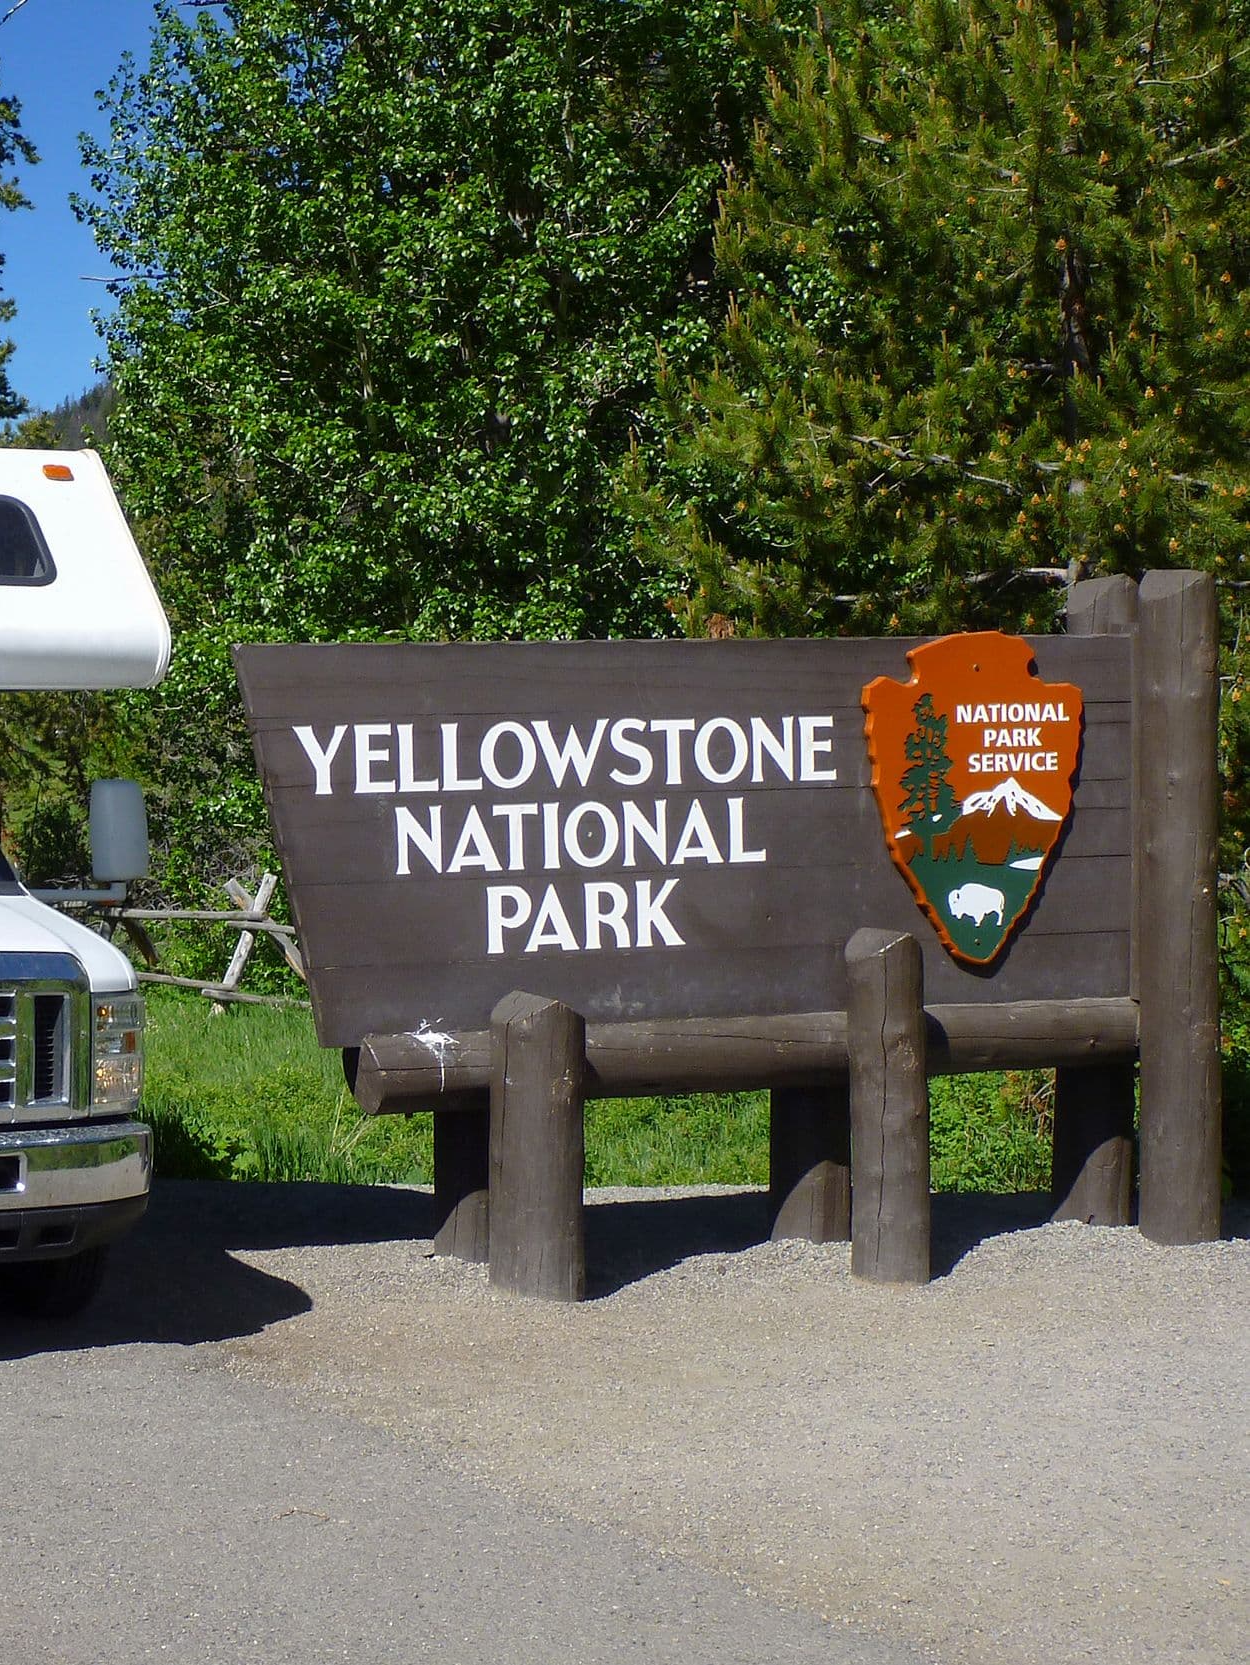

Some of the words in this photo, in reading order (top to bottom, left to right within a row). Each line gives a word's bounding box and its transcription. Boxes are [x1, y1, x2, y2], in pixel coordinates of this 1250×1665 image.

[955, 702, 1070, 723] NATIONAL
[292, 715, 838, 795] YELLOWSTONE
[983, 727, 1042, 748] PARK
[967, 752, 1059, 773] SERVICE
[395, 796, 767, 875] NATIONAL
[485, 878, 686, 954] PARK
